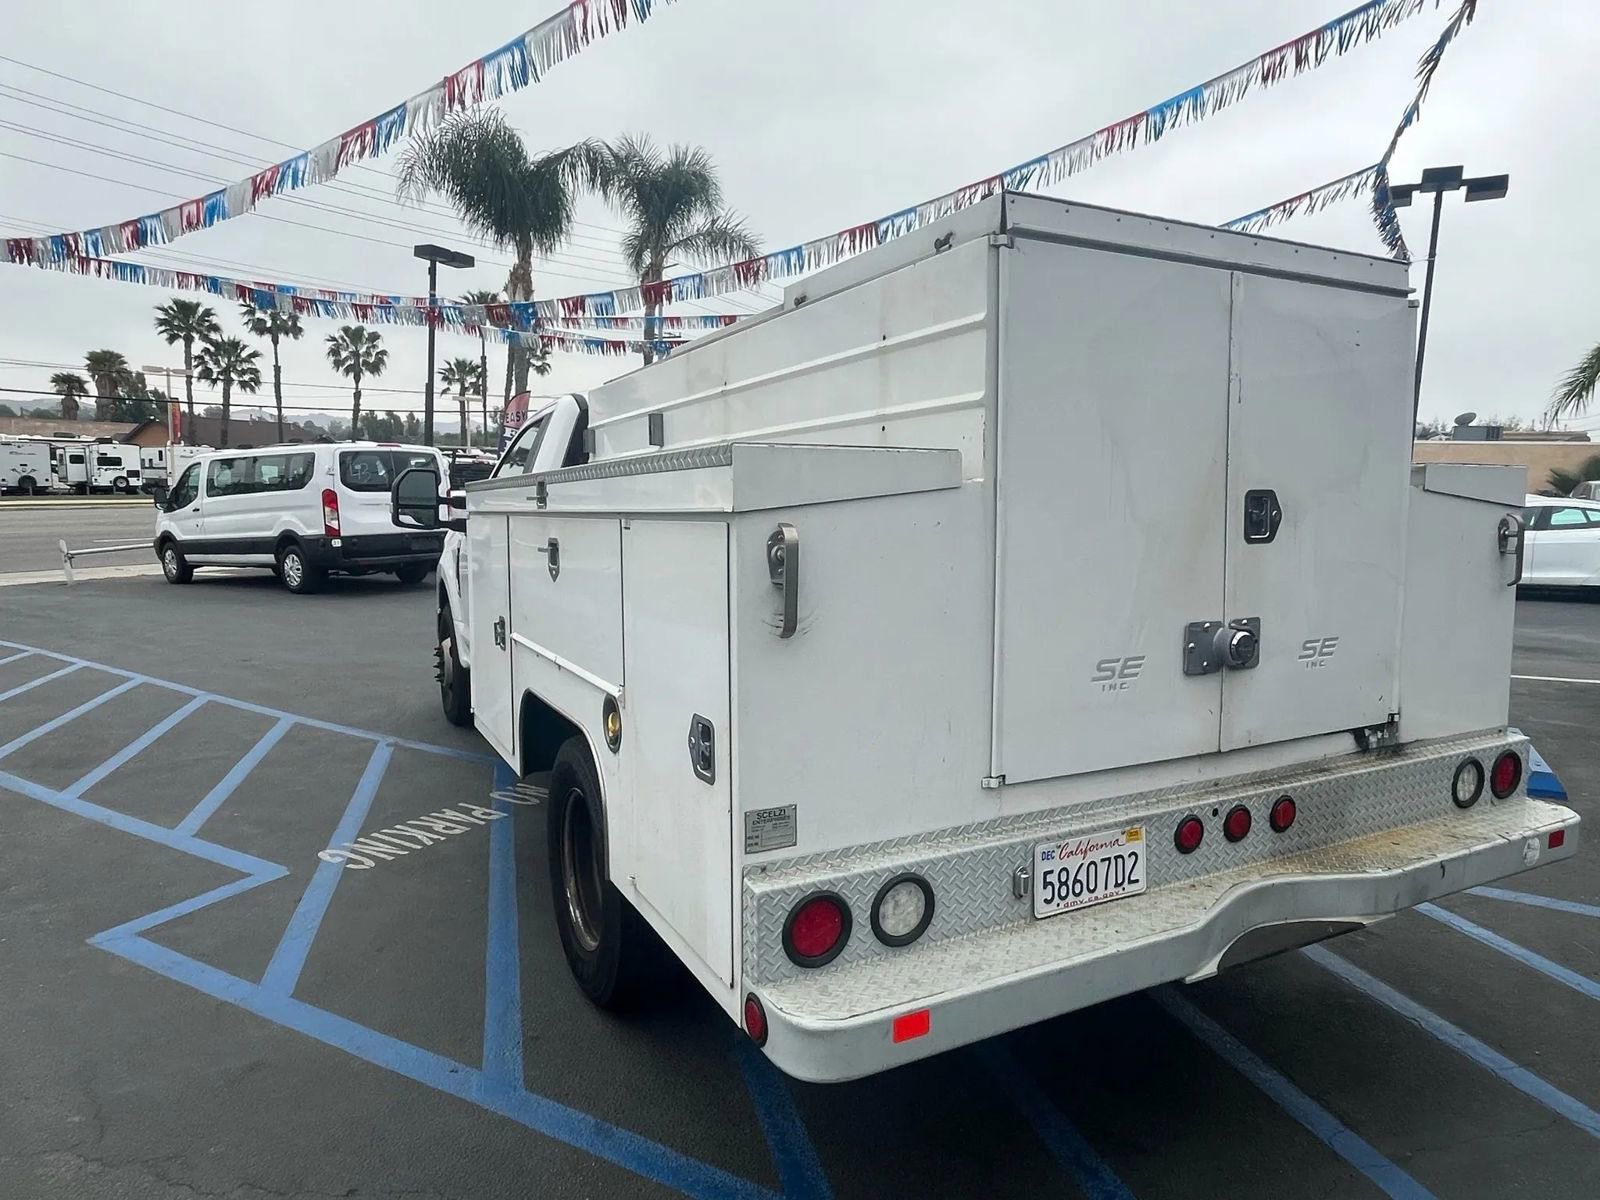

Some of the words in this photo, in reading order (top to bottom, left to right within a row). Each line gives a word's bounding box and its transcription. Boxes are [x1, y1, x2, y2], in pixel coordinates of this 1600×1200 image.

[1298, 636, 1339, 660] SE
[1091, 655, 1146, 682] SE
[1306, 660, 1326, 669] INC
[1102, 682, 1129, 692] INC
[317, 802, 508, 870] PARKING
[1041, 850, 1055, 861] DEC
[1058, 838, 1126, 861] California
[1043, 851, 1140, 905] 58607D2
